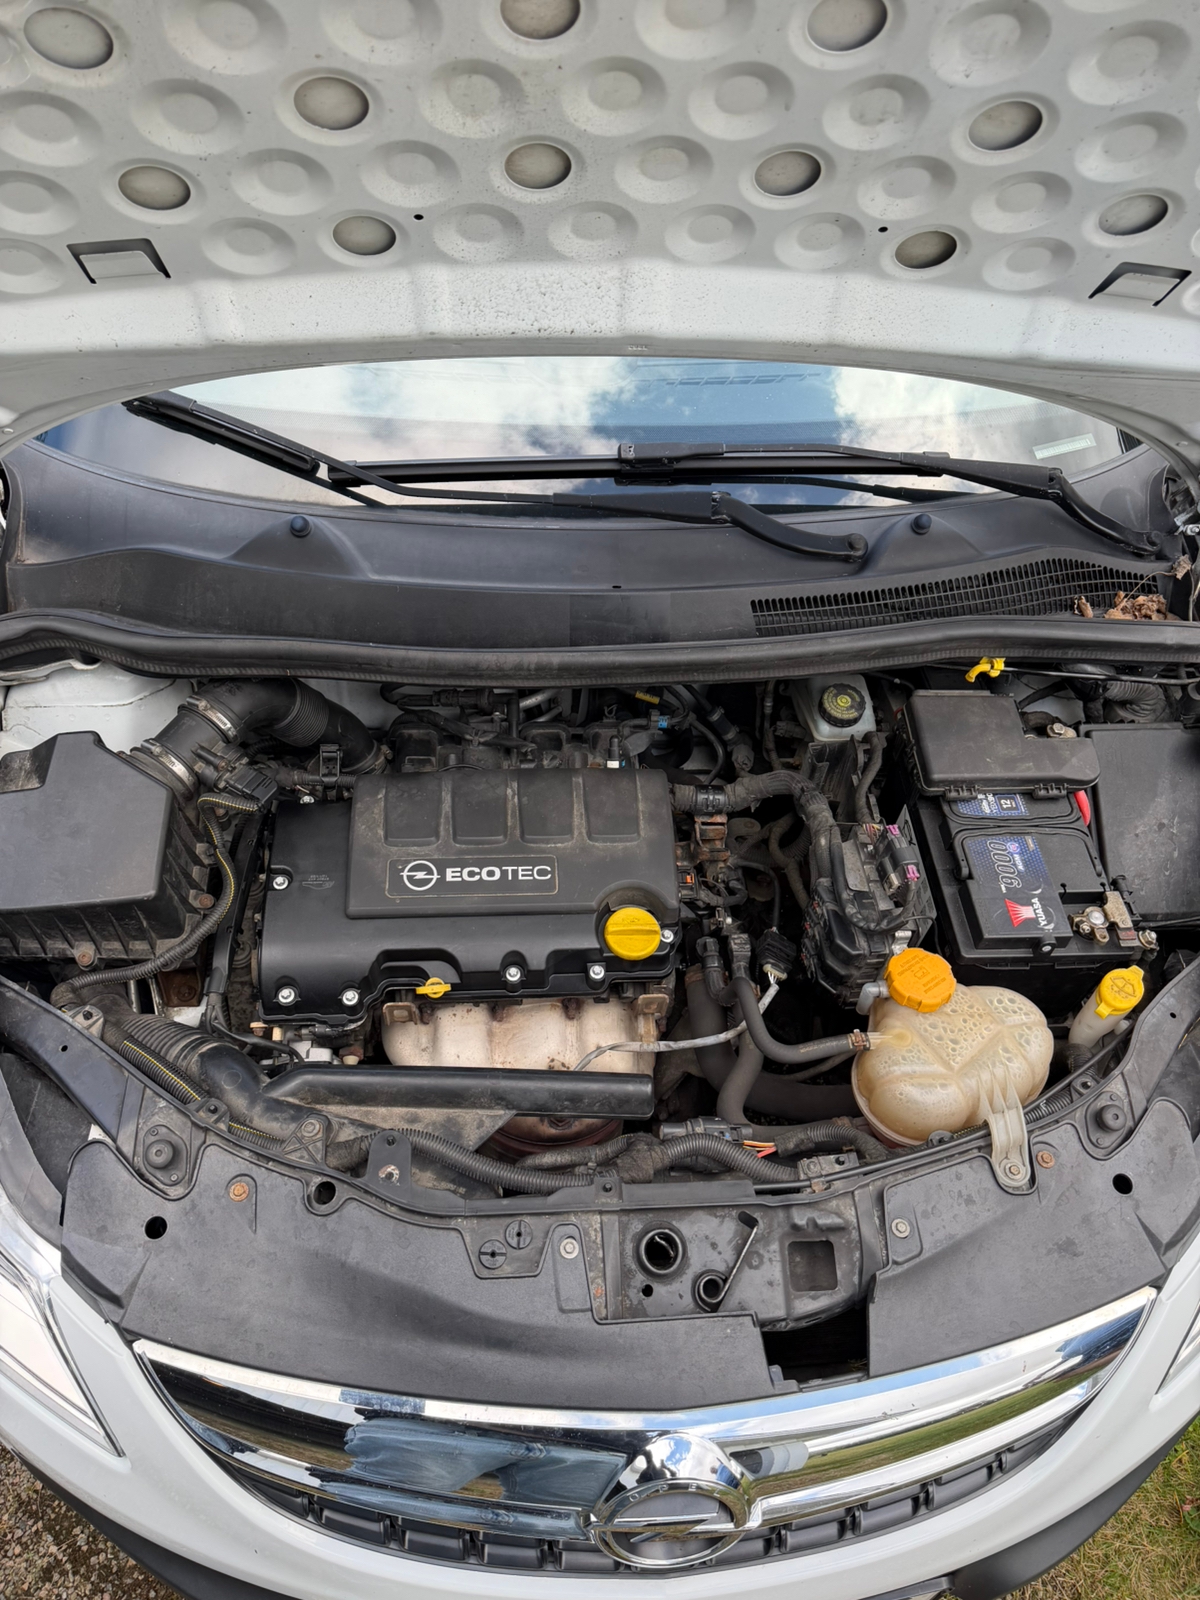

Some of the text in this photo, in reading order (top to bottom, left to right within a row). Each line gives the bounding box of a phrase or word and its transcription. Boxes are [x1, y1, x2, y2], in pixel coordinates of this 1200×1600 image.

[1000, 799, 1012, 808] 12
[445, 865, 552, 882] ECOTEC
[987, 840, 1022, 888] 9000
[1031, 897, 1048, 926] YUASA
[629, 1482, 720, 1502] OPEL
